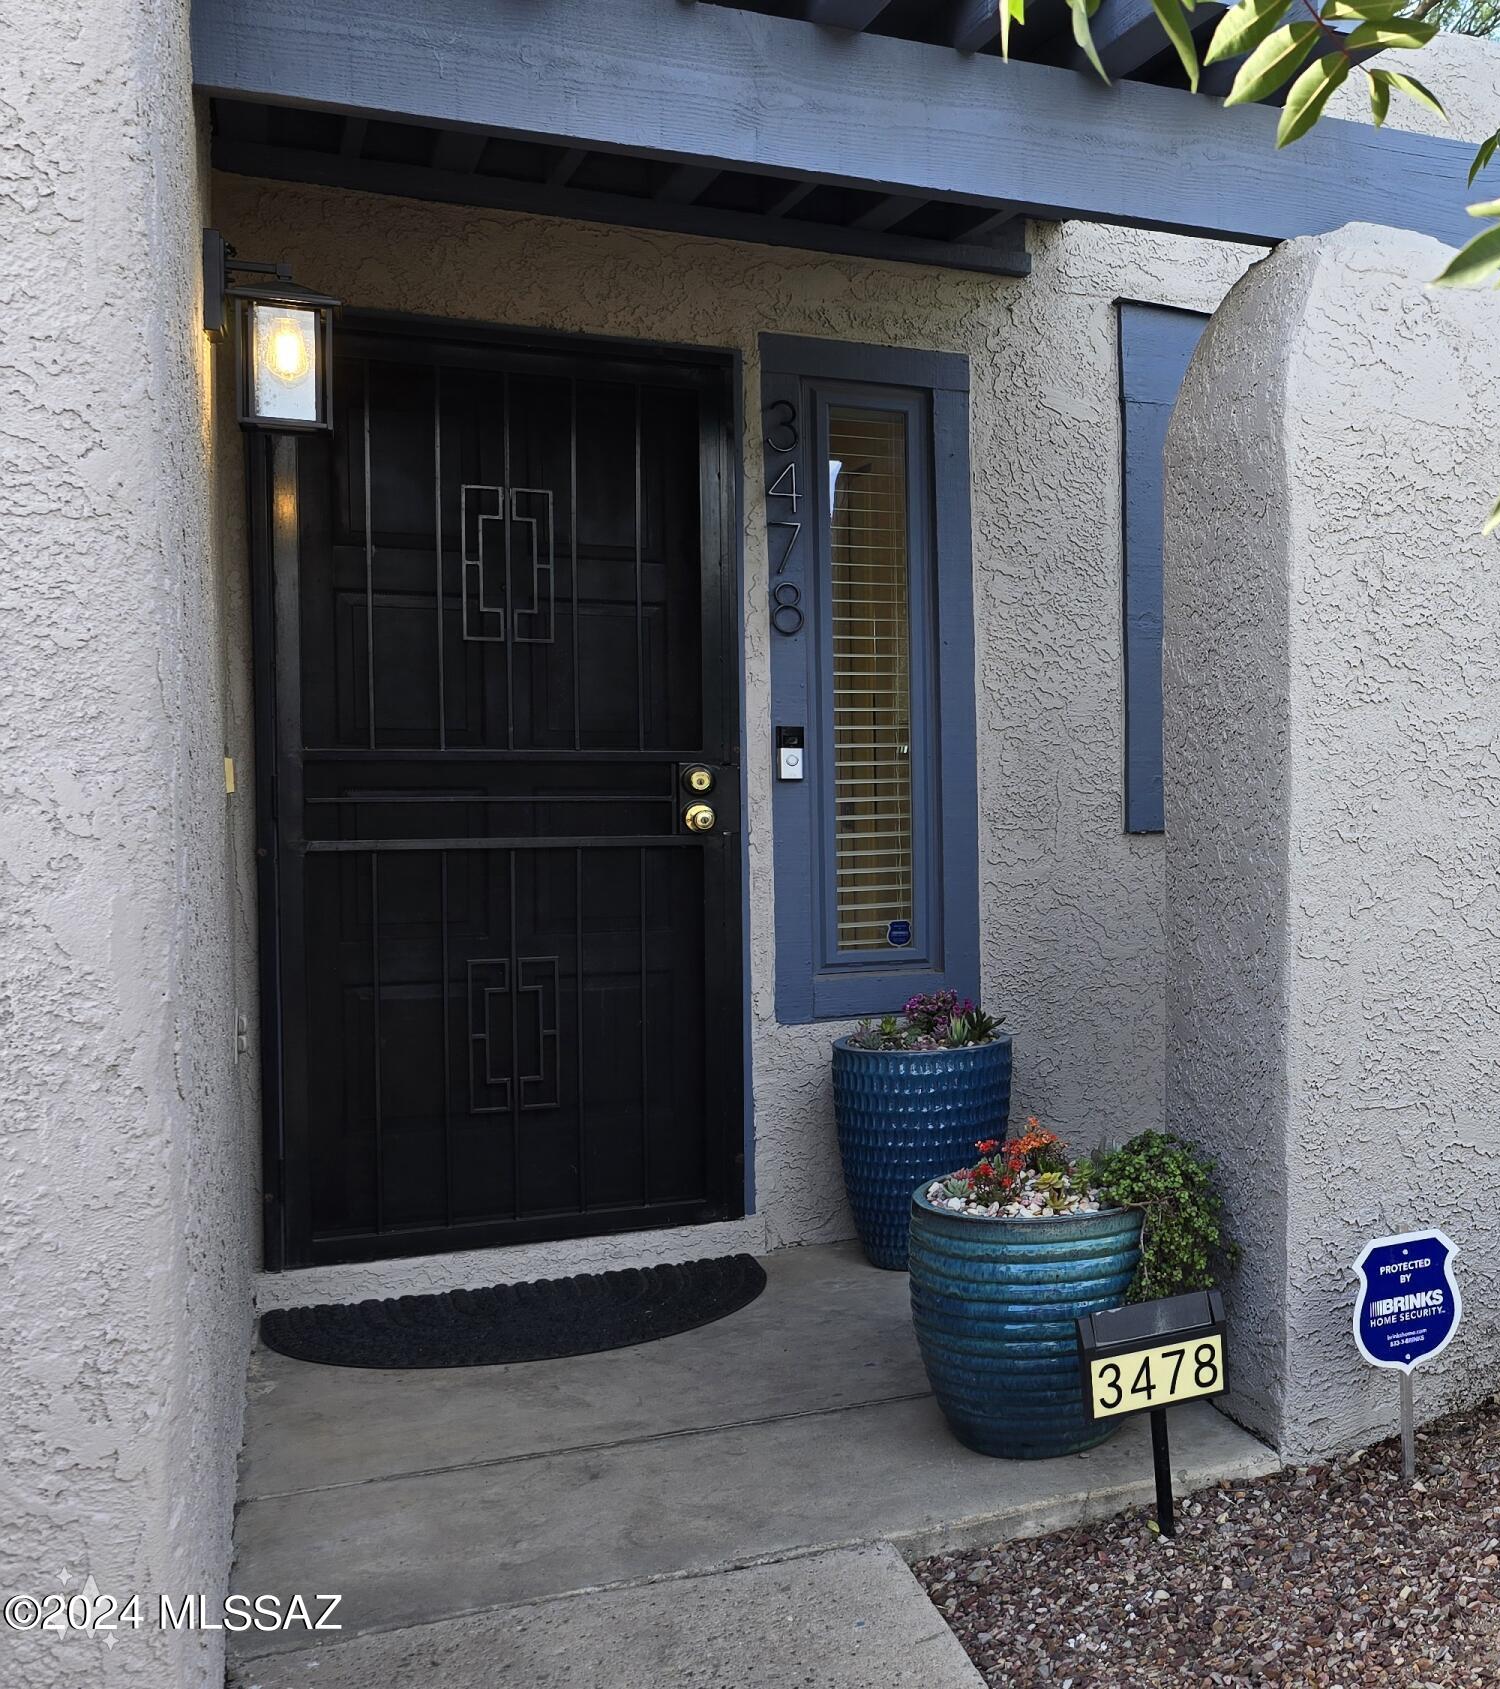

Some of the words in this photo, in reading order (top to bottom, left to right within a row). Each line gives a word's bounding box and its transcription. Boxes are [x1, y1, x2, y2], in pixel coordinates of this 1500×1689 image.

[767, 400, 804, 635] 3478
[1379, 1257, 1431, 1276] PROTECTED
[1399, 1273, 1412, 1284] BY
[1382, 1288, 1444, 1316] BRINKS
[1370, 1314, 1398, 1328] HOME
[1399, 1305, 1443, 1322] SECURITY
[1098, 1343, 1218, 1409] 3478
